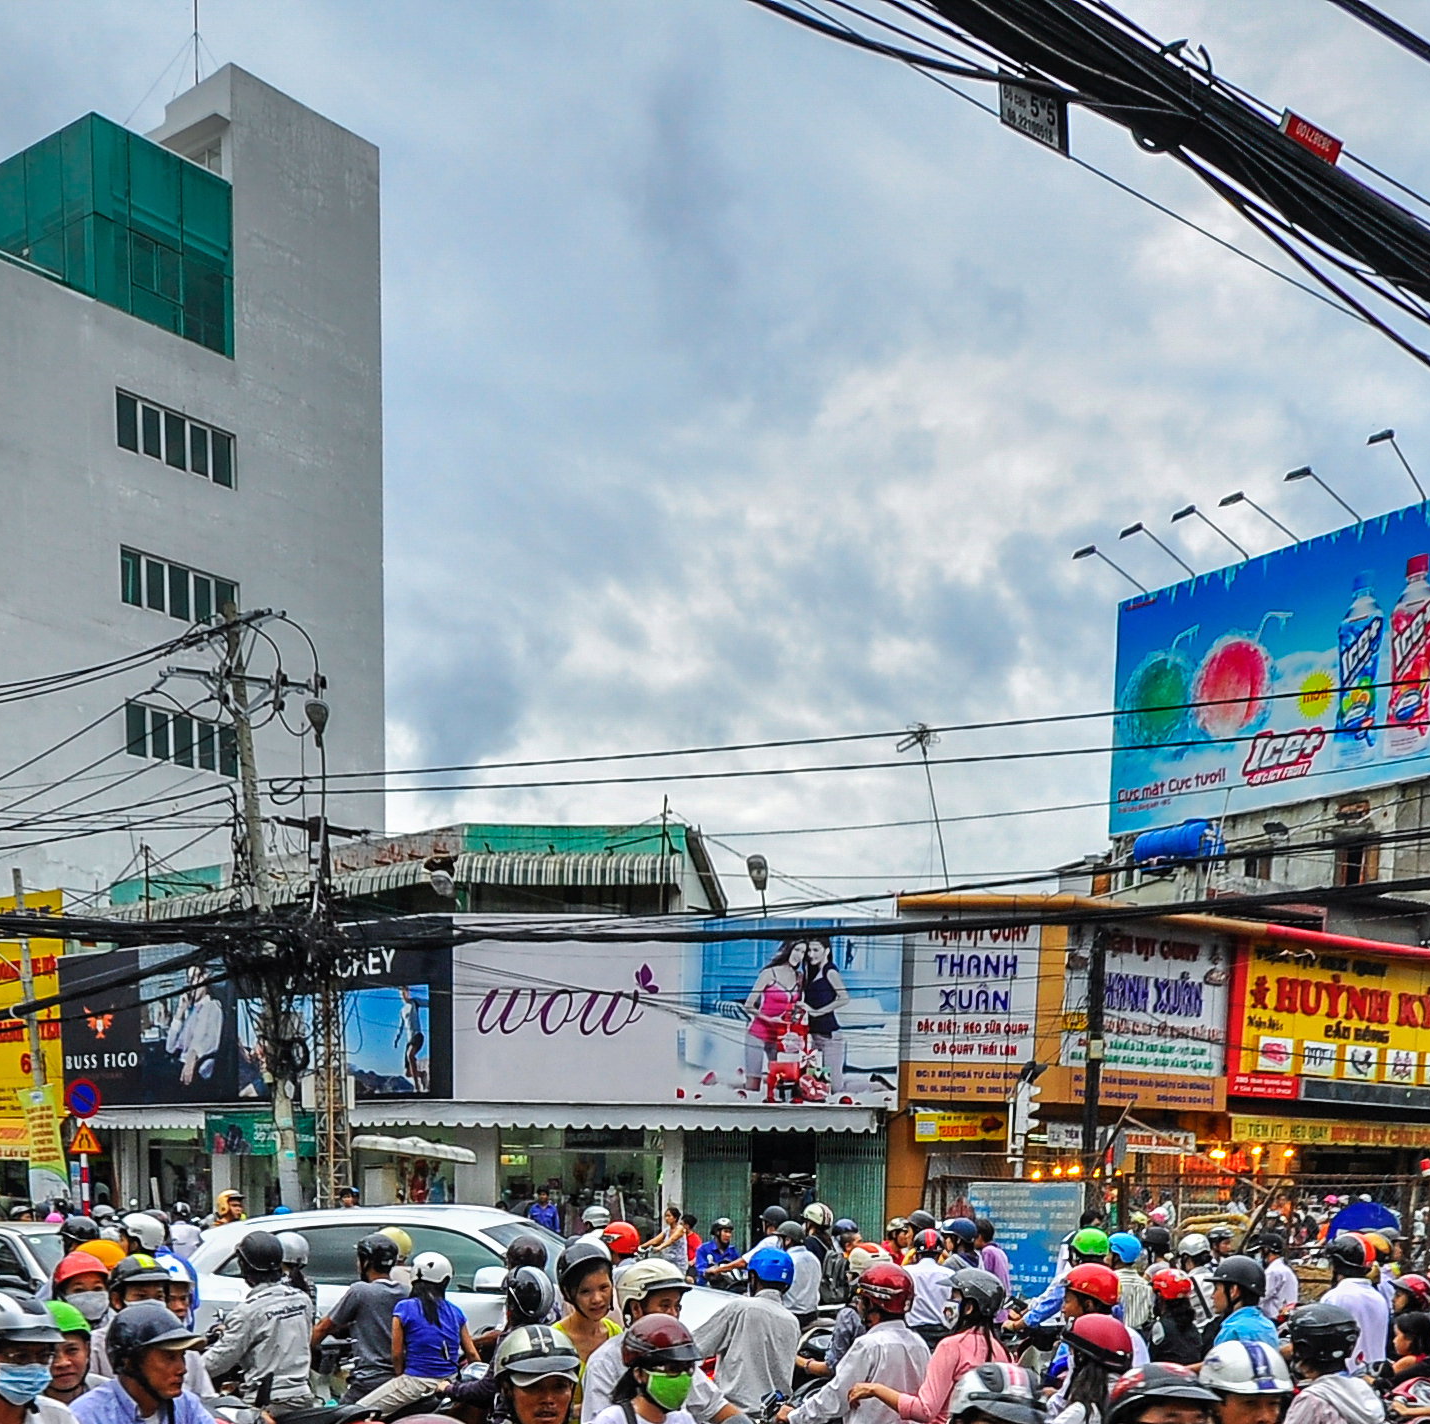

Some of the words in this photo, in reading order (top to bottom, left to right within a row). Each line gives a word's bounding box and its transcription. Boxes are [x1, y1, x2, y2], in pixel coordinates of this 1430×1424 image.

[935, 953, 1019, 978] THANH
[939, 983, 1010, 1012] XUÂN
[1105, 972, 1150, 1012] HANH
[476, 988, 644, 1036] wow
[65, 1053, 97, 1070] BUSS
[104, 1051, 138, 1069] FIGO
